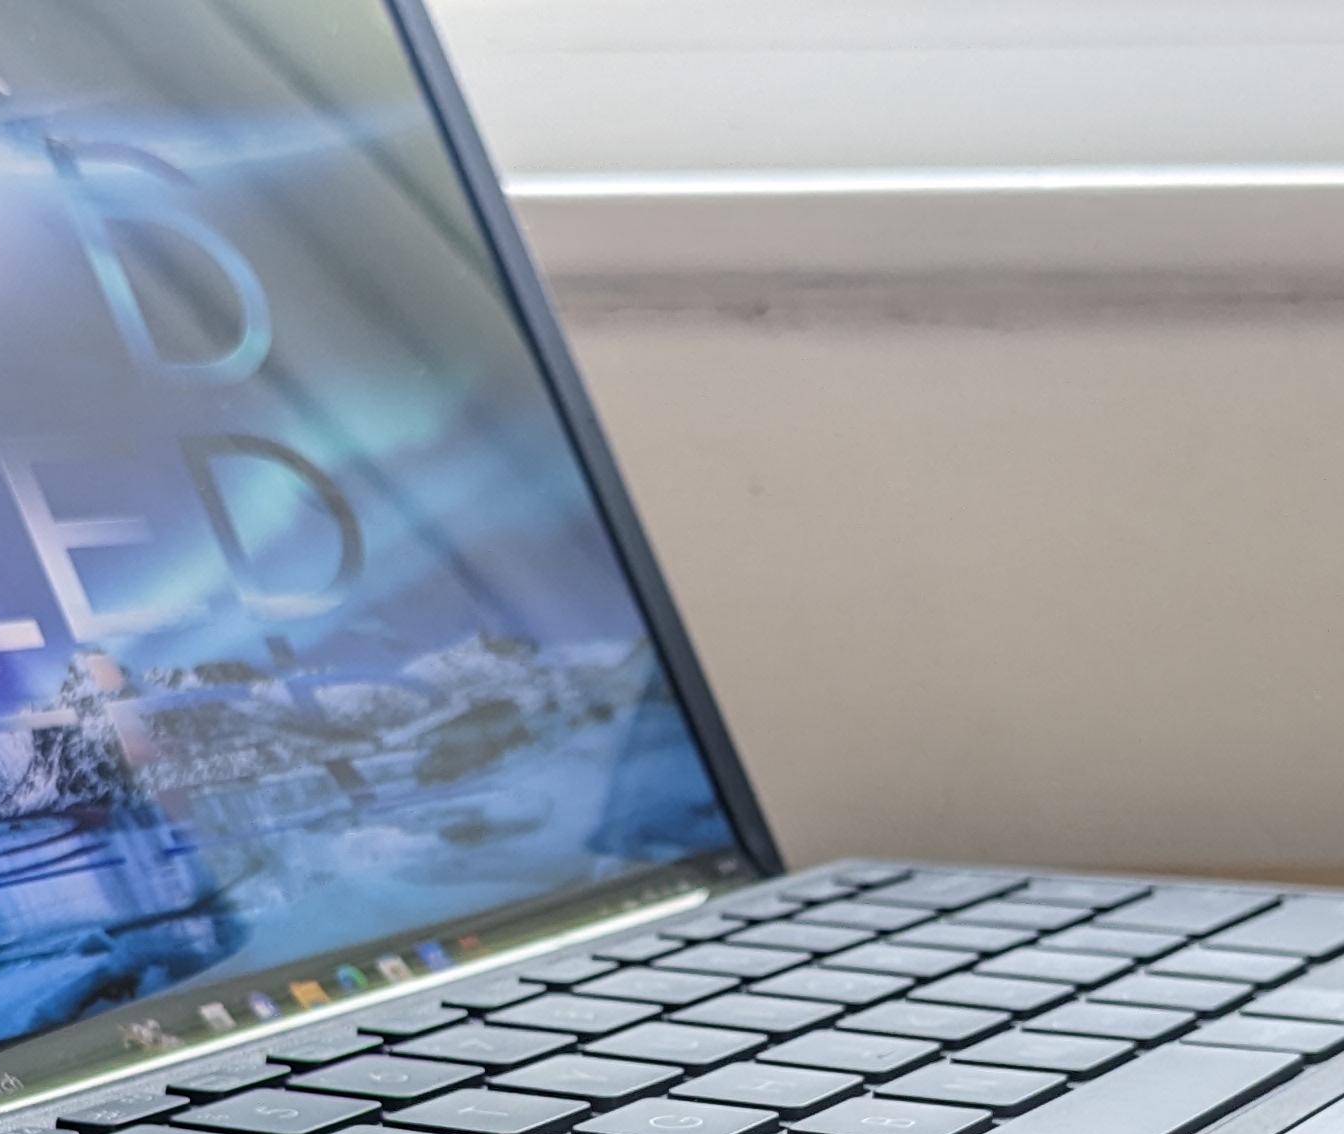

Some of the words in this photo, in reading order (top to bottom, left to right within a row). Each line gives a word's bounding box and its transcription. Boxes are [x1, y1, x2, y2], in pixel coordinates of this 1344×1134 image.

[253, 1104, 300, 1120] 5
[456, 1104, 509, 1117] T
[647, 1113, 705, 1130] G
[859, 1115, 917, 1129] B
